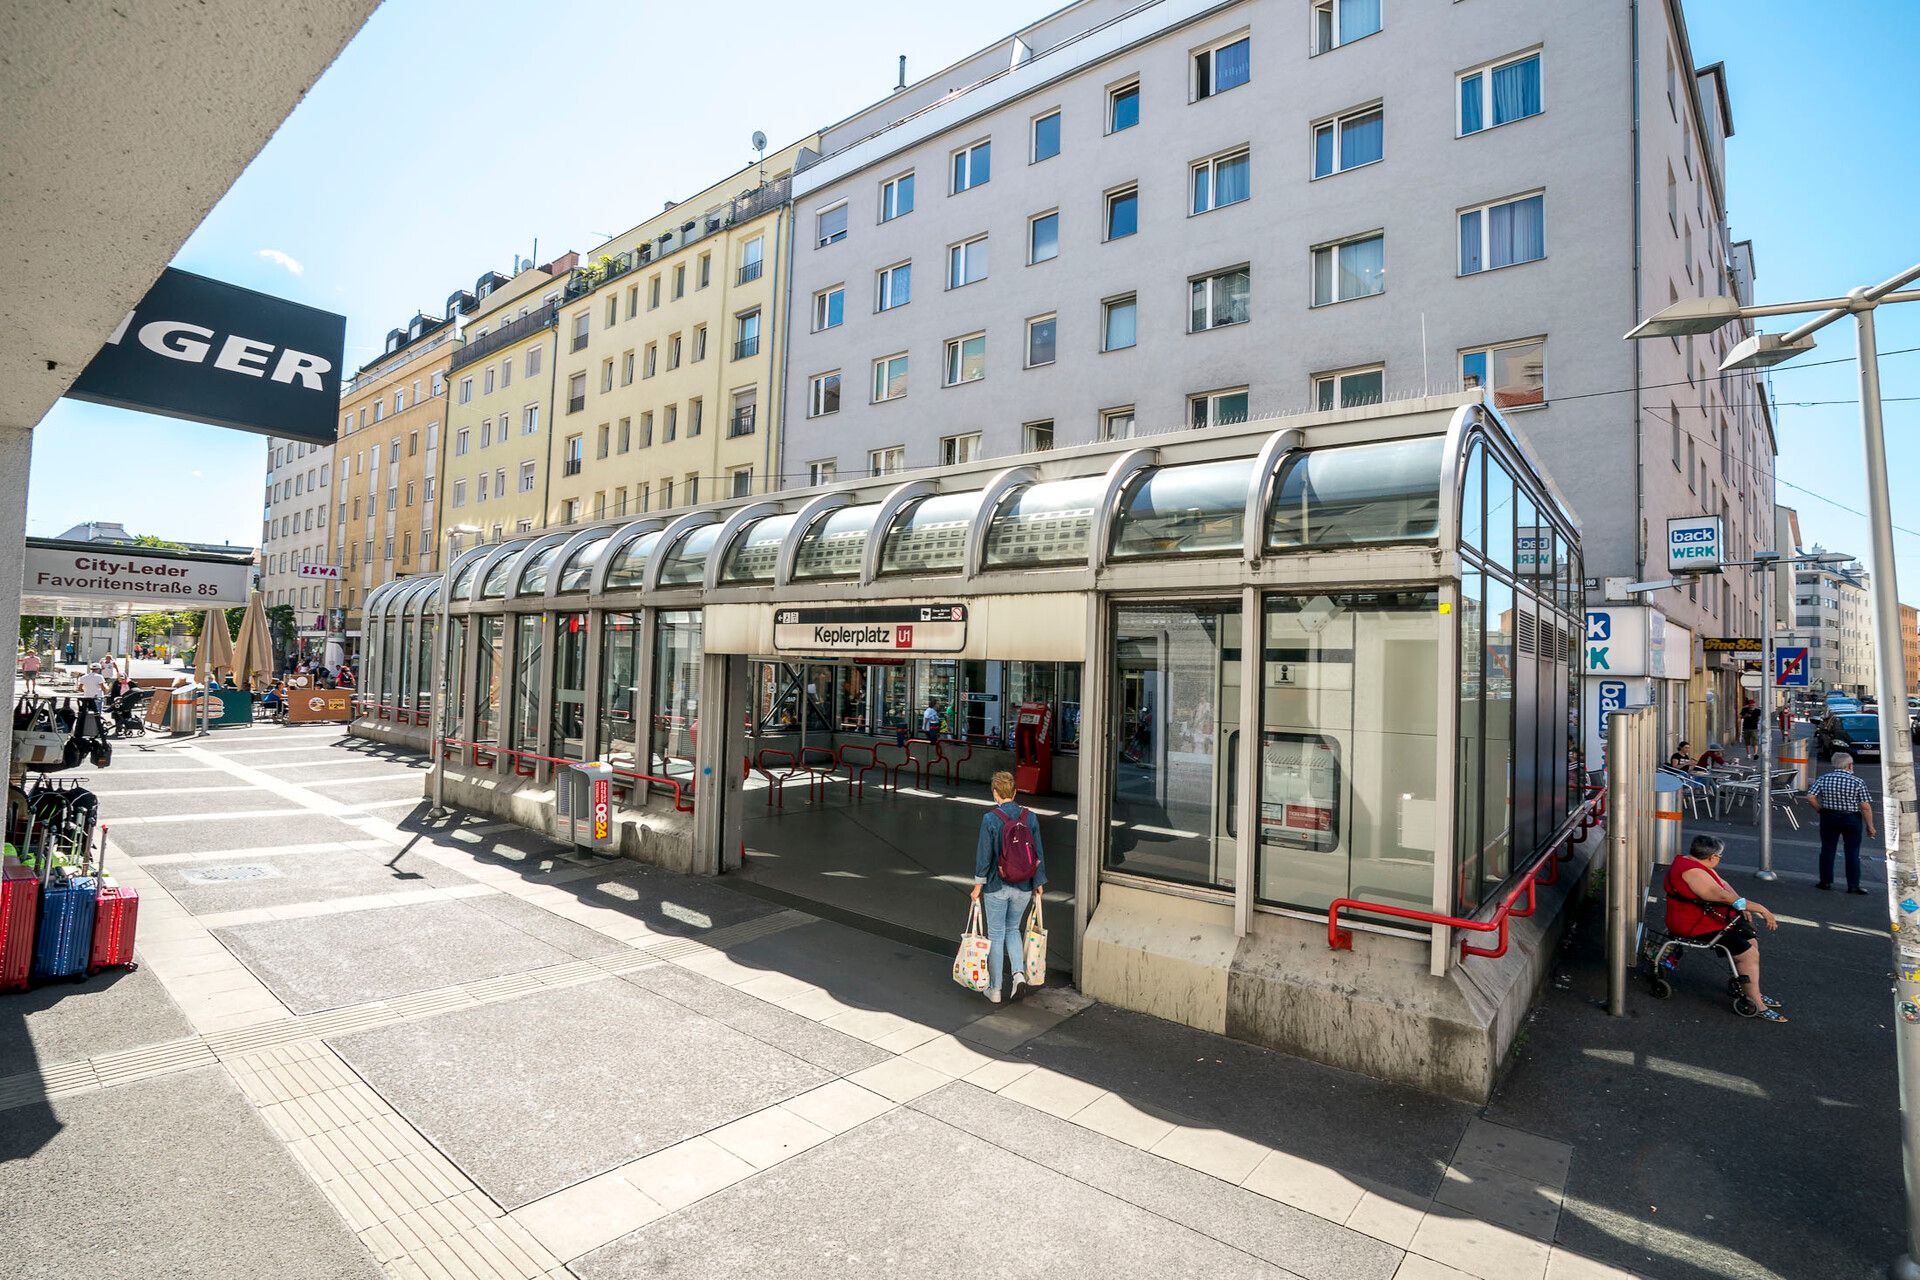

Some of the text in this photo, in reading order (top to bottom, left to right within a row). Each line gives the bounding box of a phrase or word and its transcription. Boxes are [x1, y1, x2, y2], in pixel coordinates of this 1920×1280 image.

[1674, 529, 1712, 542] back
[1672, 546, 1715, 559] WERK
[75, 557, 189, 578] City-Leder
[303, 566, 337, 576] SEWA
[37, 572, 218, 596] Favoritenstraße 85
[815, 626, 910, 646] Keplerplatz U1
